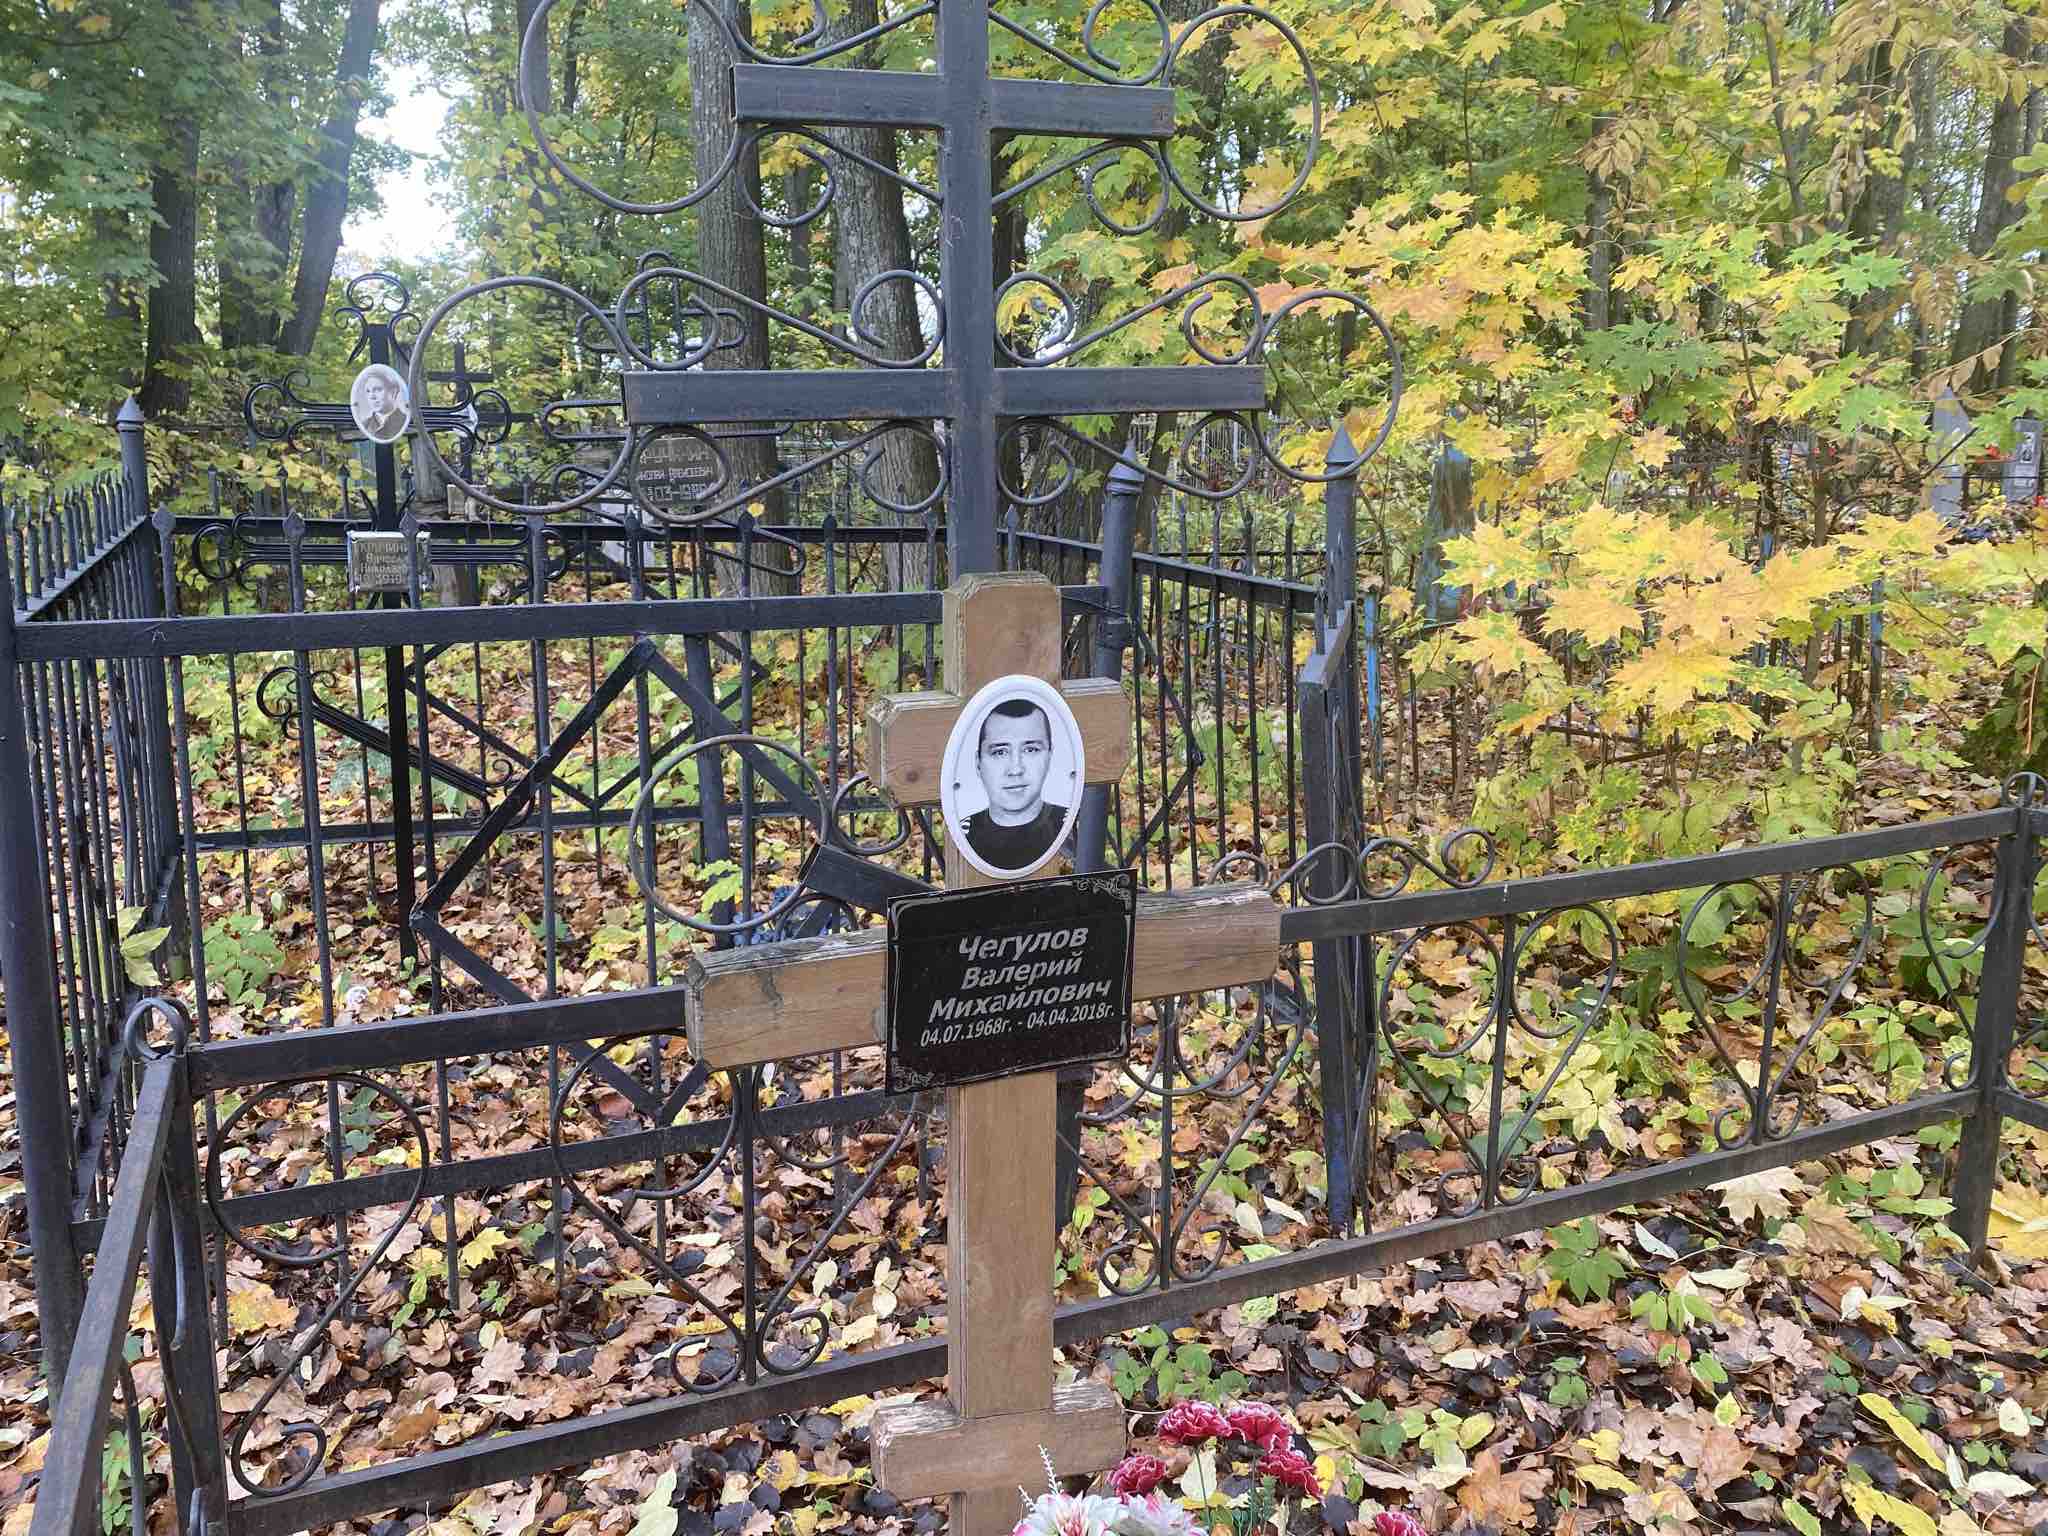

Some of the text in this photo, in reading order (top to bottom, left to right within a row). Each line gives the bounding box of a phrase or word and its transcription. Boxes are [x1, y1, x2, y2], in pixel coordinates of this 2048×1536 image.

[959, 927, 1089, 963] Чегулов
[960, 951, 1083, 990] Валерий
[928, 978, 1113, 1024] Михайлович
[920, 1017, 1013, 1047] 04.07.1968г.
[1027, 1003, 1115, 1030] 04.04.2018г.
